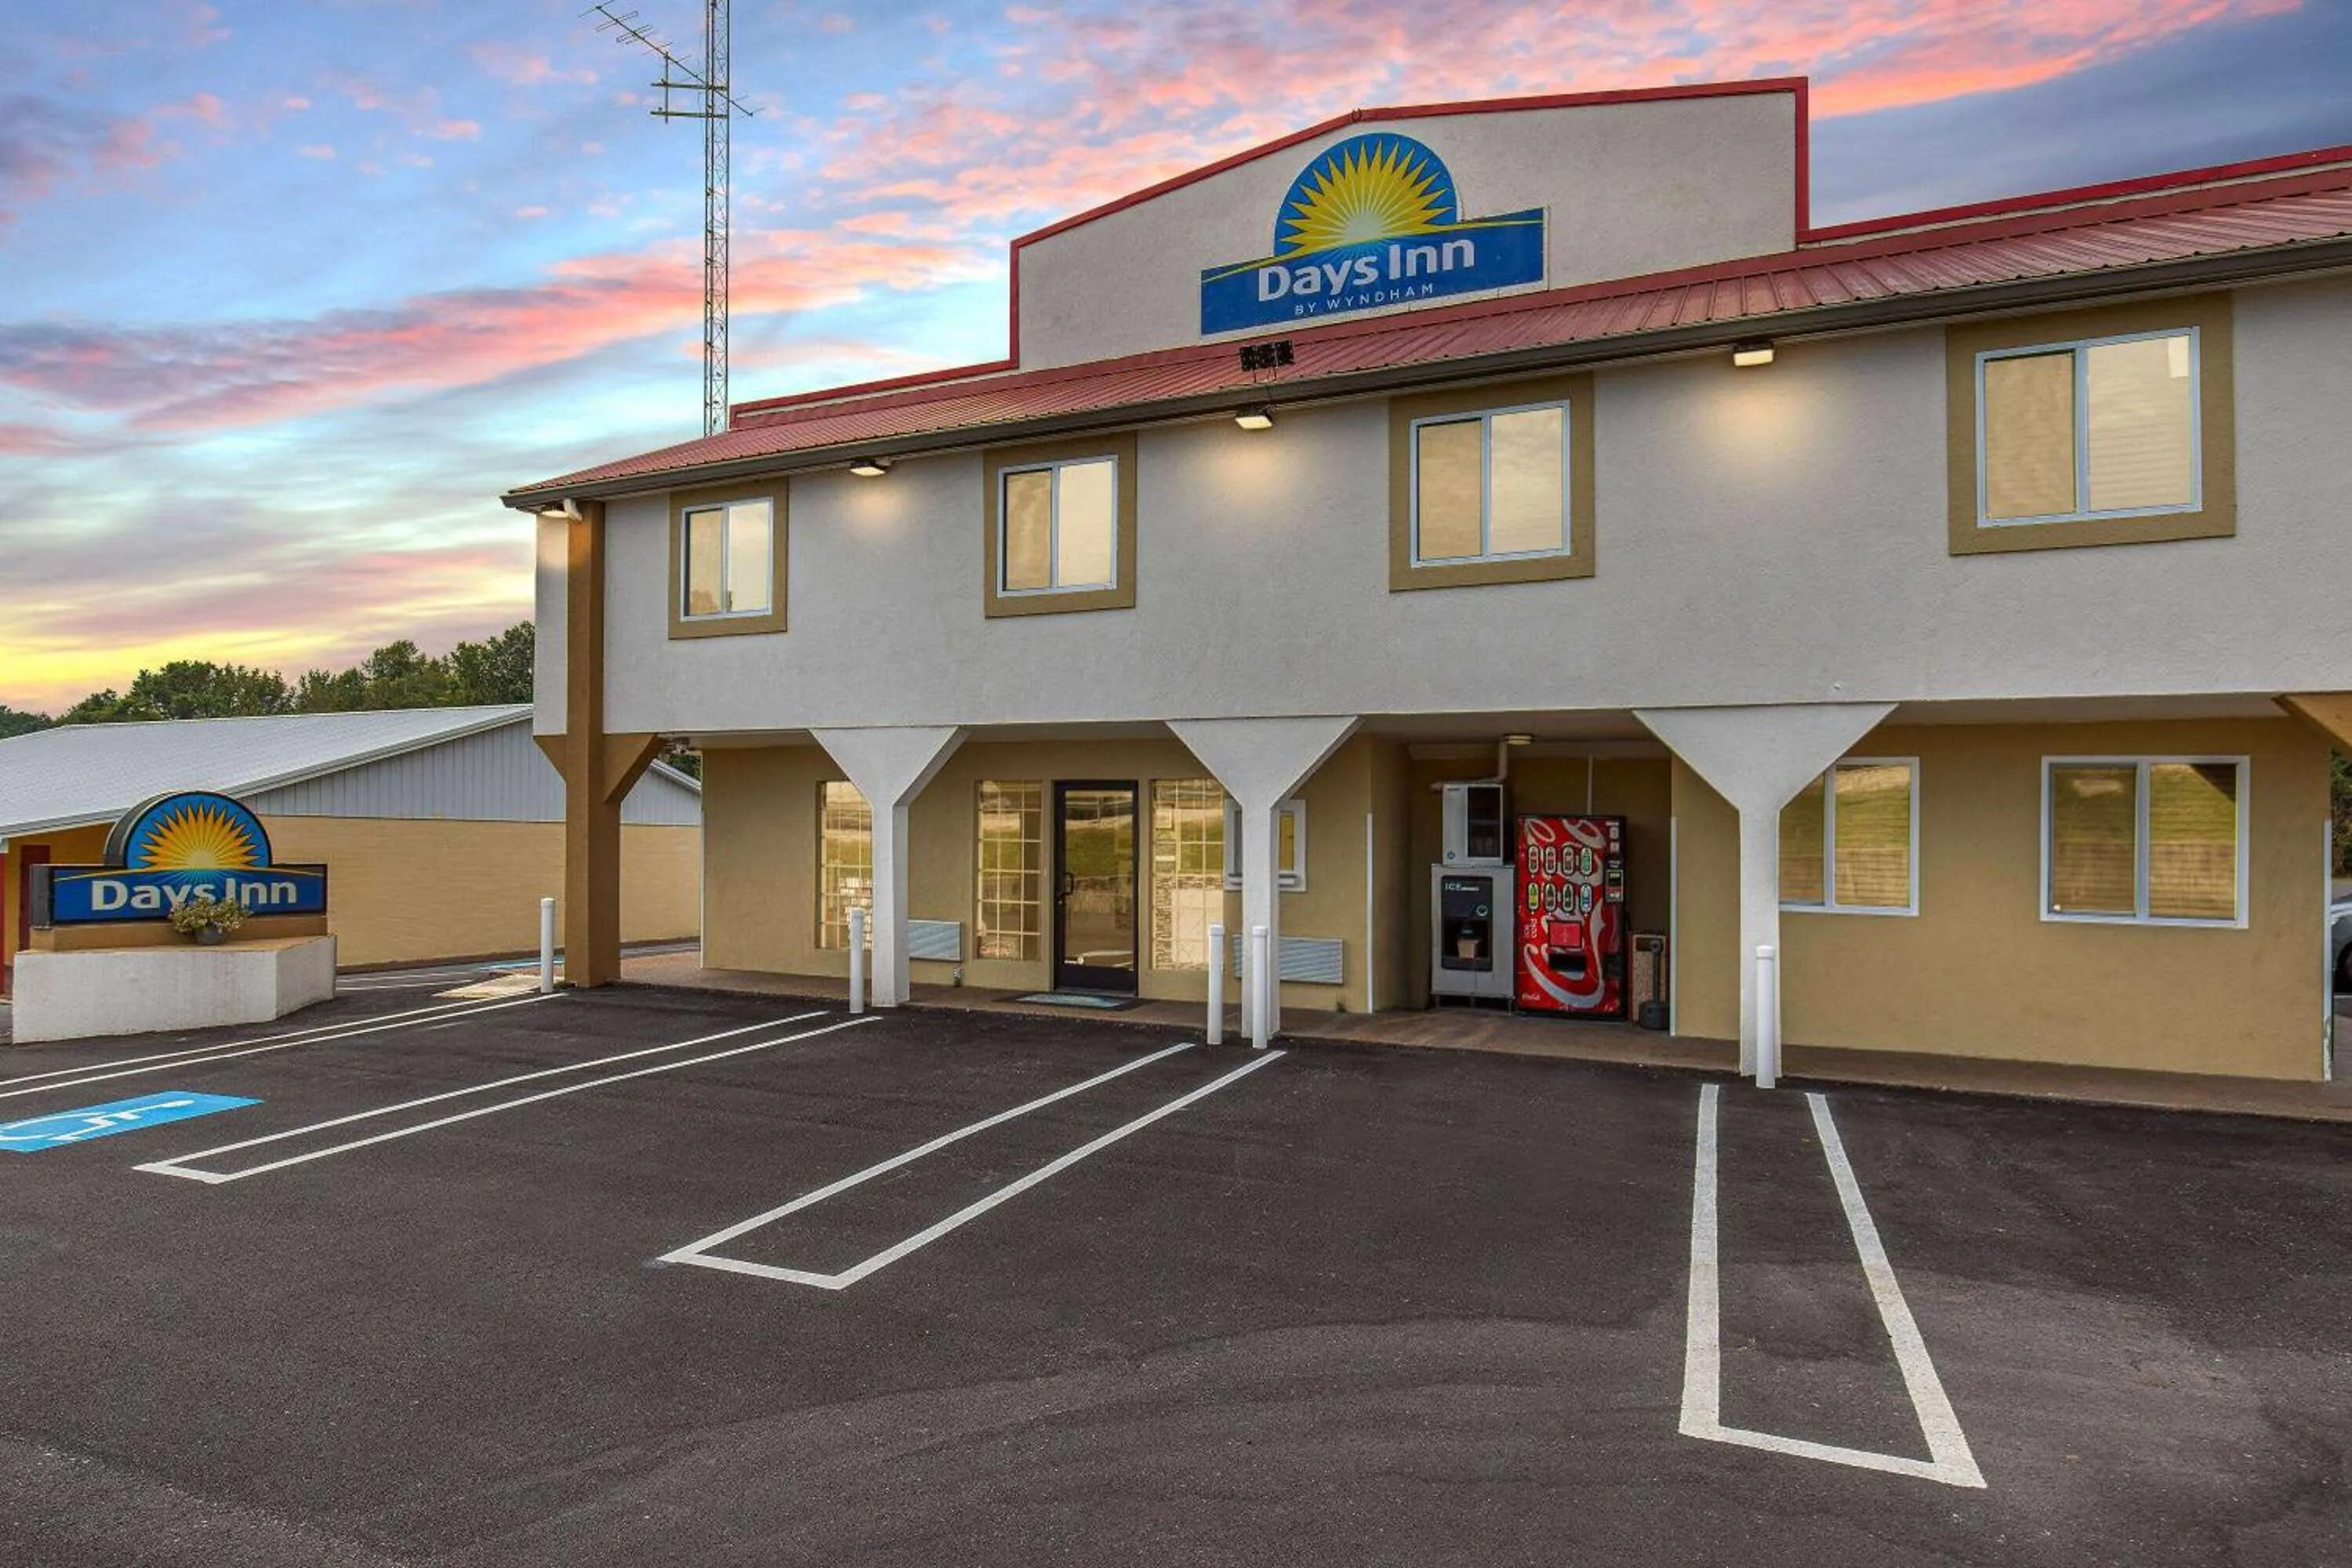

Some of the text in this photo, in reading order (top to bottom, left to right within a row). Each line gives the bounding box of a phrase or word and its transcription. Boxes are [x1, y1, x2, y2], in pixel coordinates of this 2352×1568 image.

[1258, 238, 1475, 302] Days Inn
[1294, 283, 1434, 314] BY WYNDHAM
[92, 878, 297, 913] Days Inn
